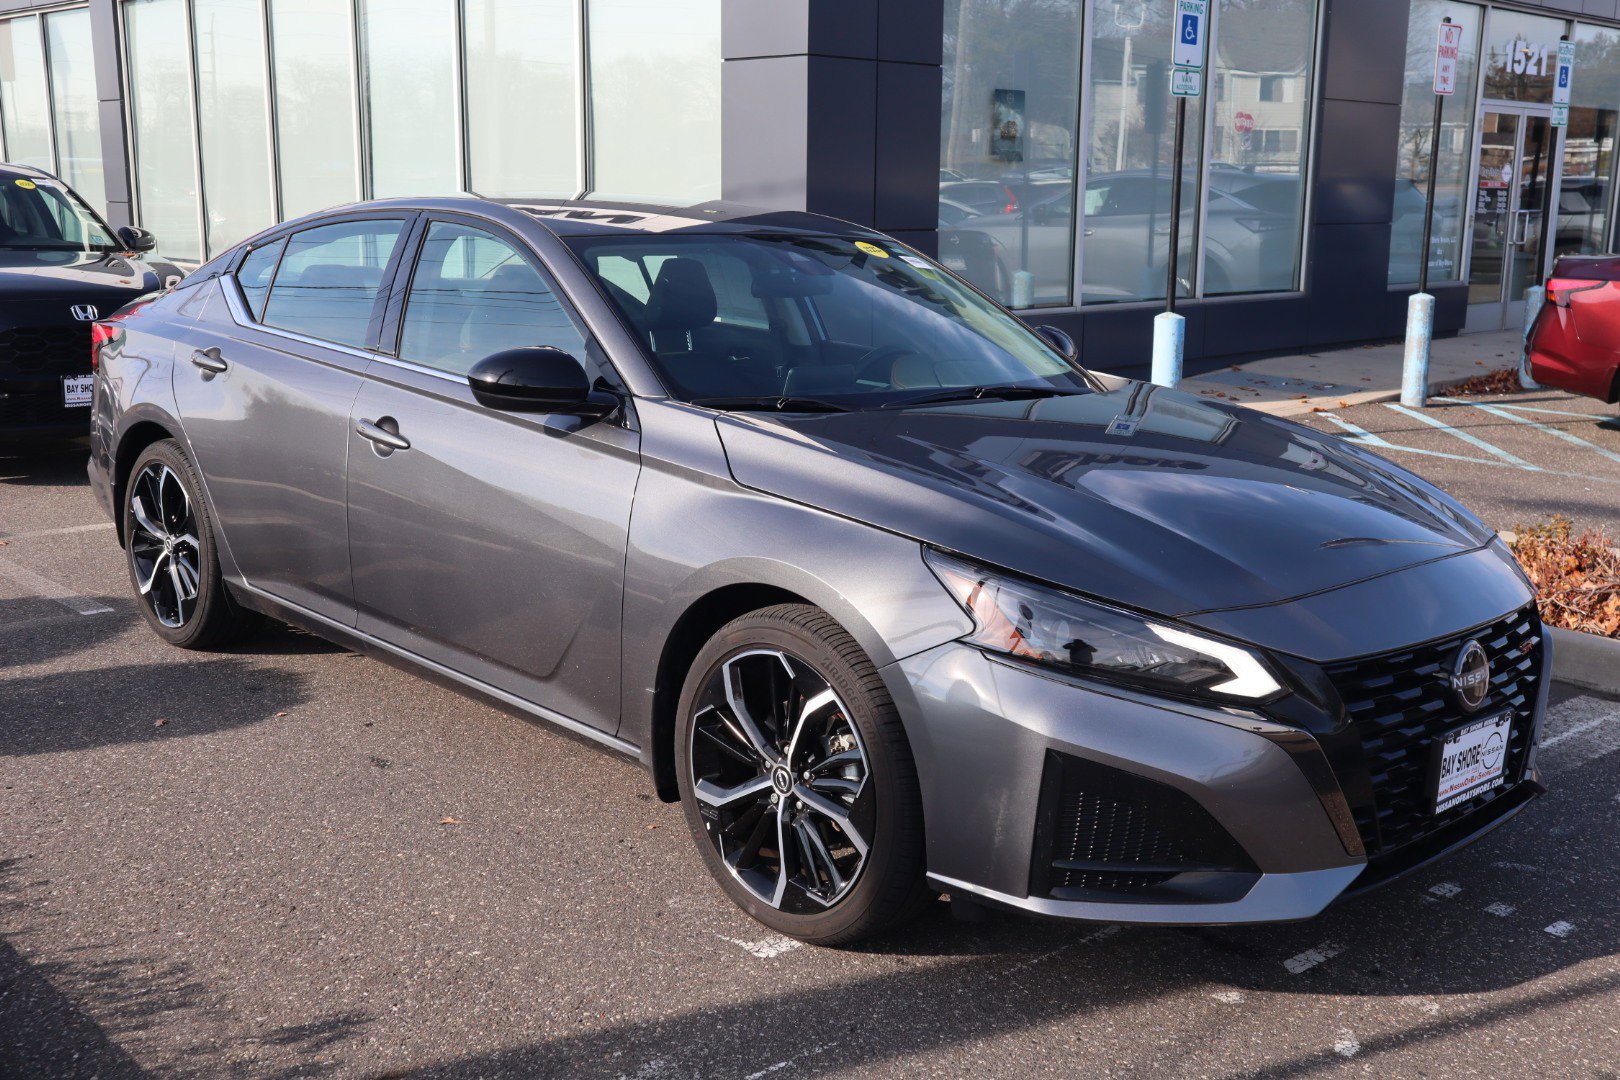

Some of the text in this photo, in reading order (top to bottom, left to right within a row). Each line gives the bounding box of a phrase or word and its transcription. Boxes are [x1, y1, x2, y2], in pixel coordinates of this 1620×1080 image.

[1179, 1, 1203, 14] PARKING
[1445, 30, 1453, 43] NO
[1439, 45, 1457, 59] PARKING
[1506, 40, 1548, 76] 1521
[1182, 75, 1192, 83] VAN
[66, 384, 79, 393] BAY
[1482, 745, 1503, 757] NISSAN
[1441, 754, 1457, 778] BAY
[1456, 744, 1481, 772] SHORE
[1435, 777, 1504, 815] NISSANOFBAYSHORE.COM
